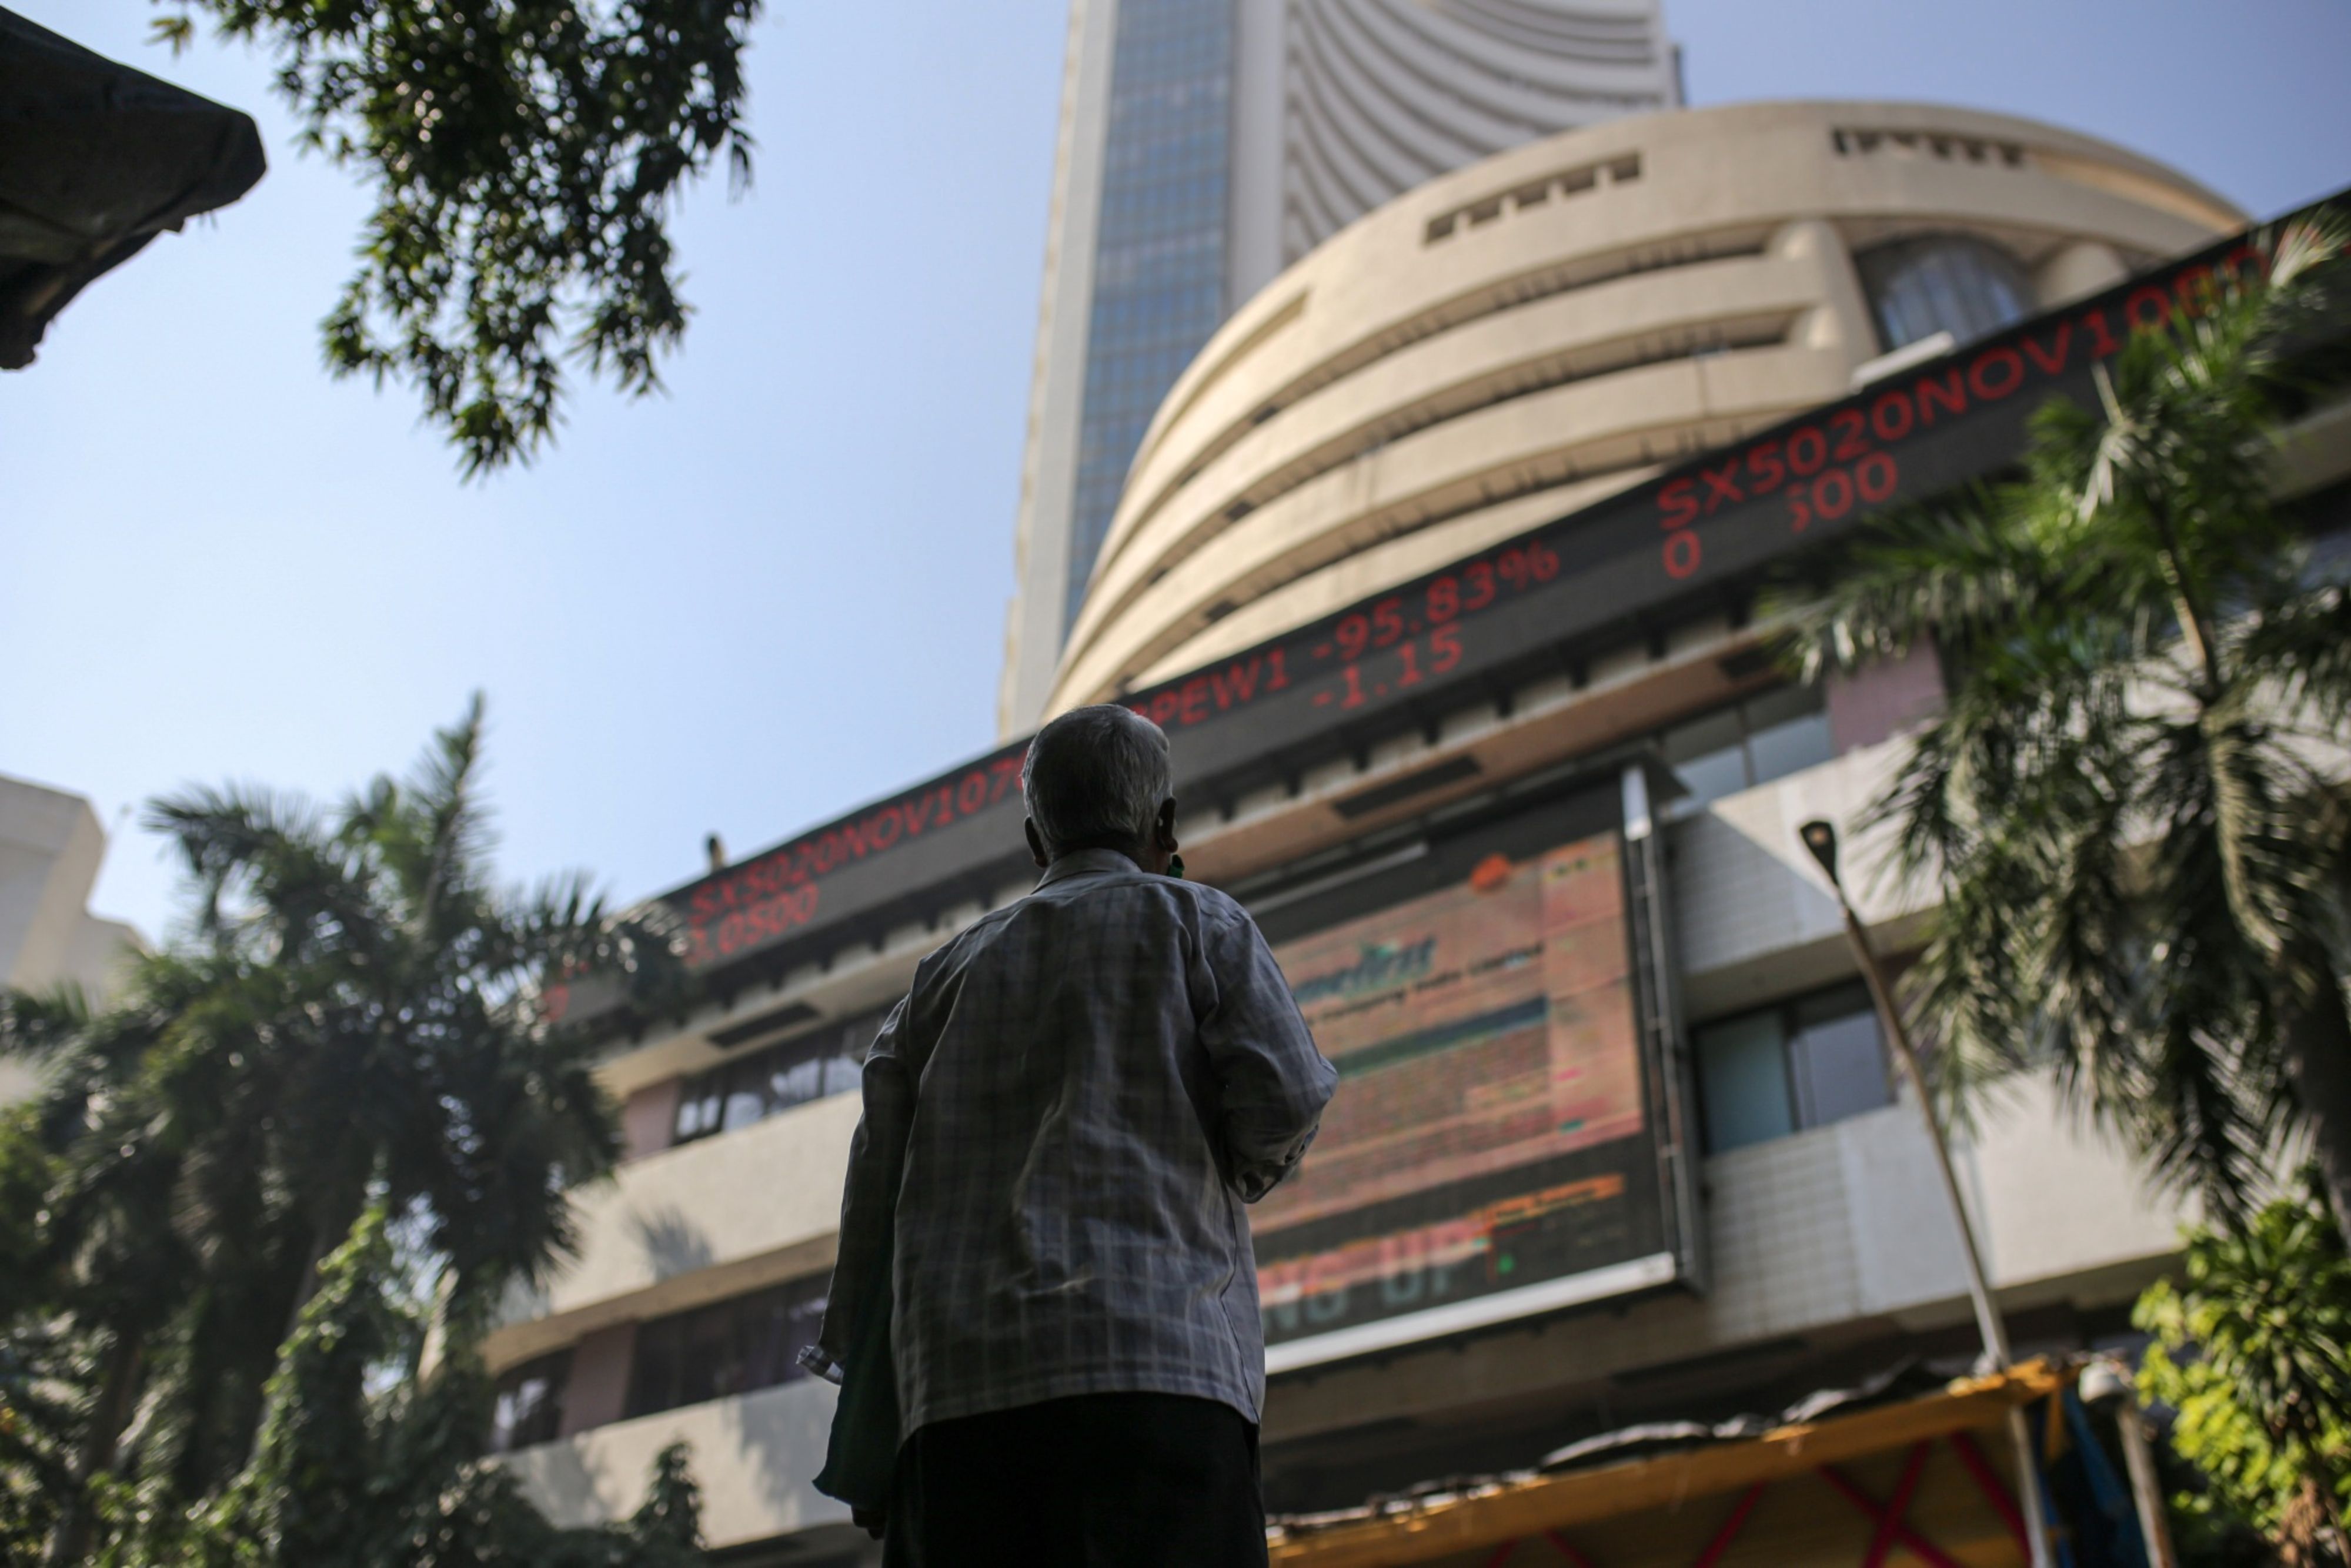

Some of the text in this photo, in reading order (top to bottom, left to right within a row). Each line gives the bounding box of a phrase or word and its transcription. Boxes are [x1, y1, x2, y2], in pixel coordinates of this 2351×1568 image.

[1130, 648, 1291, 728] PEW1
[1311, 540, 1561, 661] -95.83%
[1311, 621, 1464, 710] -1.15
